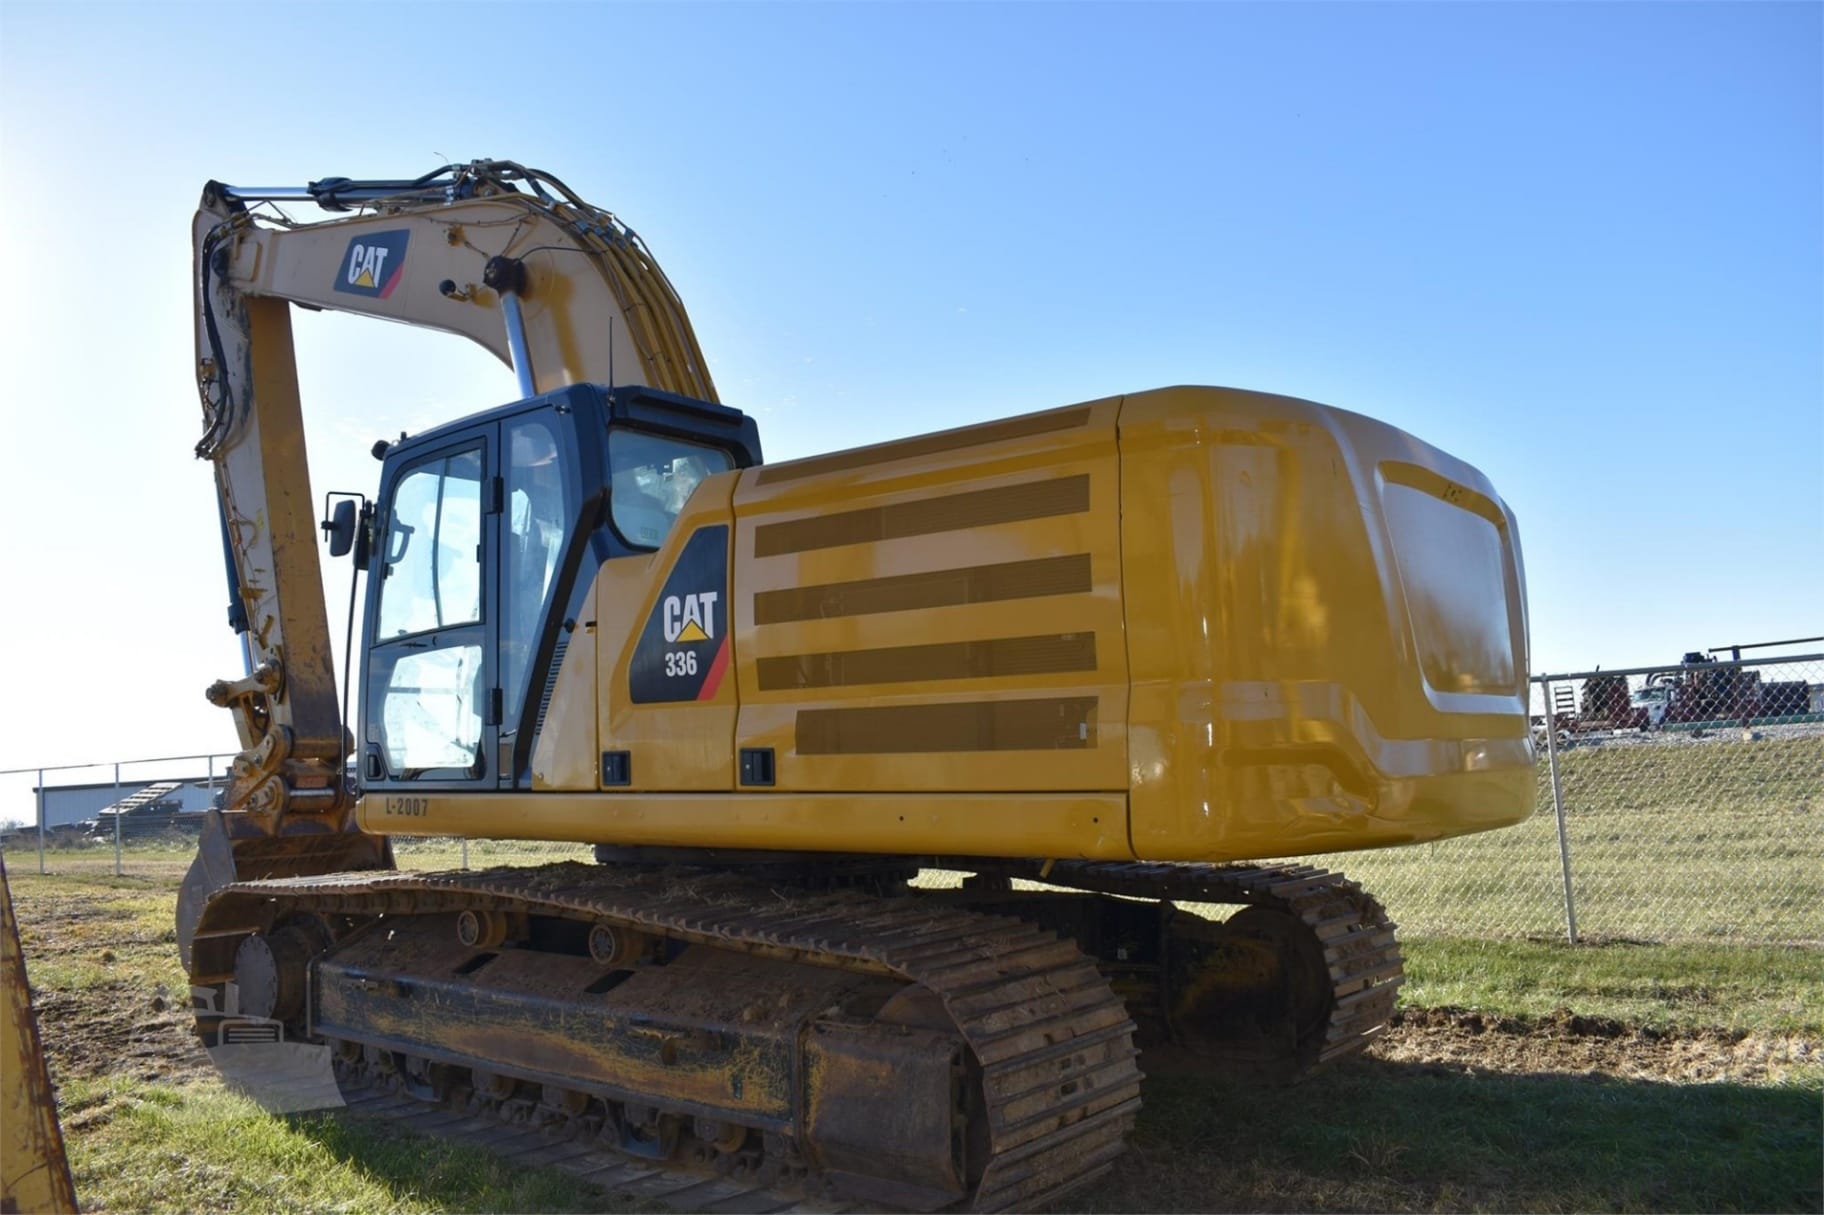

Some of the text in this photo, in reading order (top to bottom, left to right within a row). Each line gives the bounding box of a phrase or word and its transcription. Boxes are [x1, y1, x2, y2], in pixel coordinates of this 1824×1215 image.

[348, 244, 388, 288] CAT
[664, 592, 718, 643] CAT
[665, 651, 697, 677] 336
[386, 797, 428, 816] L-2007
